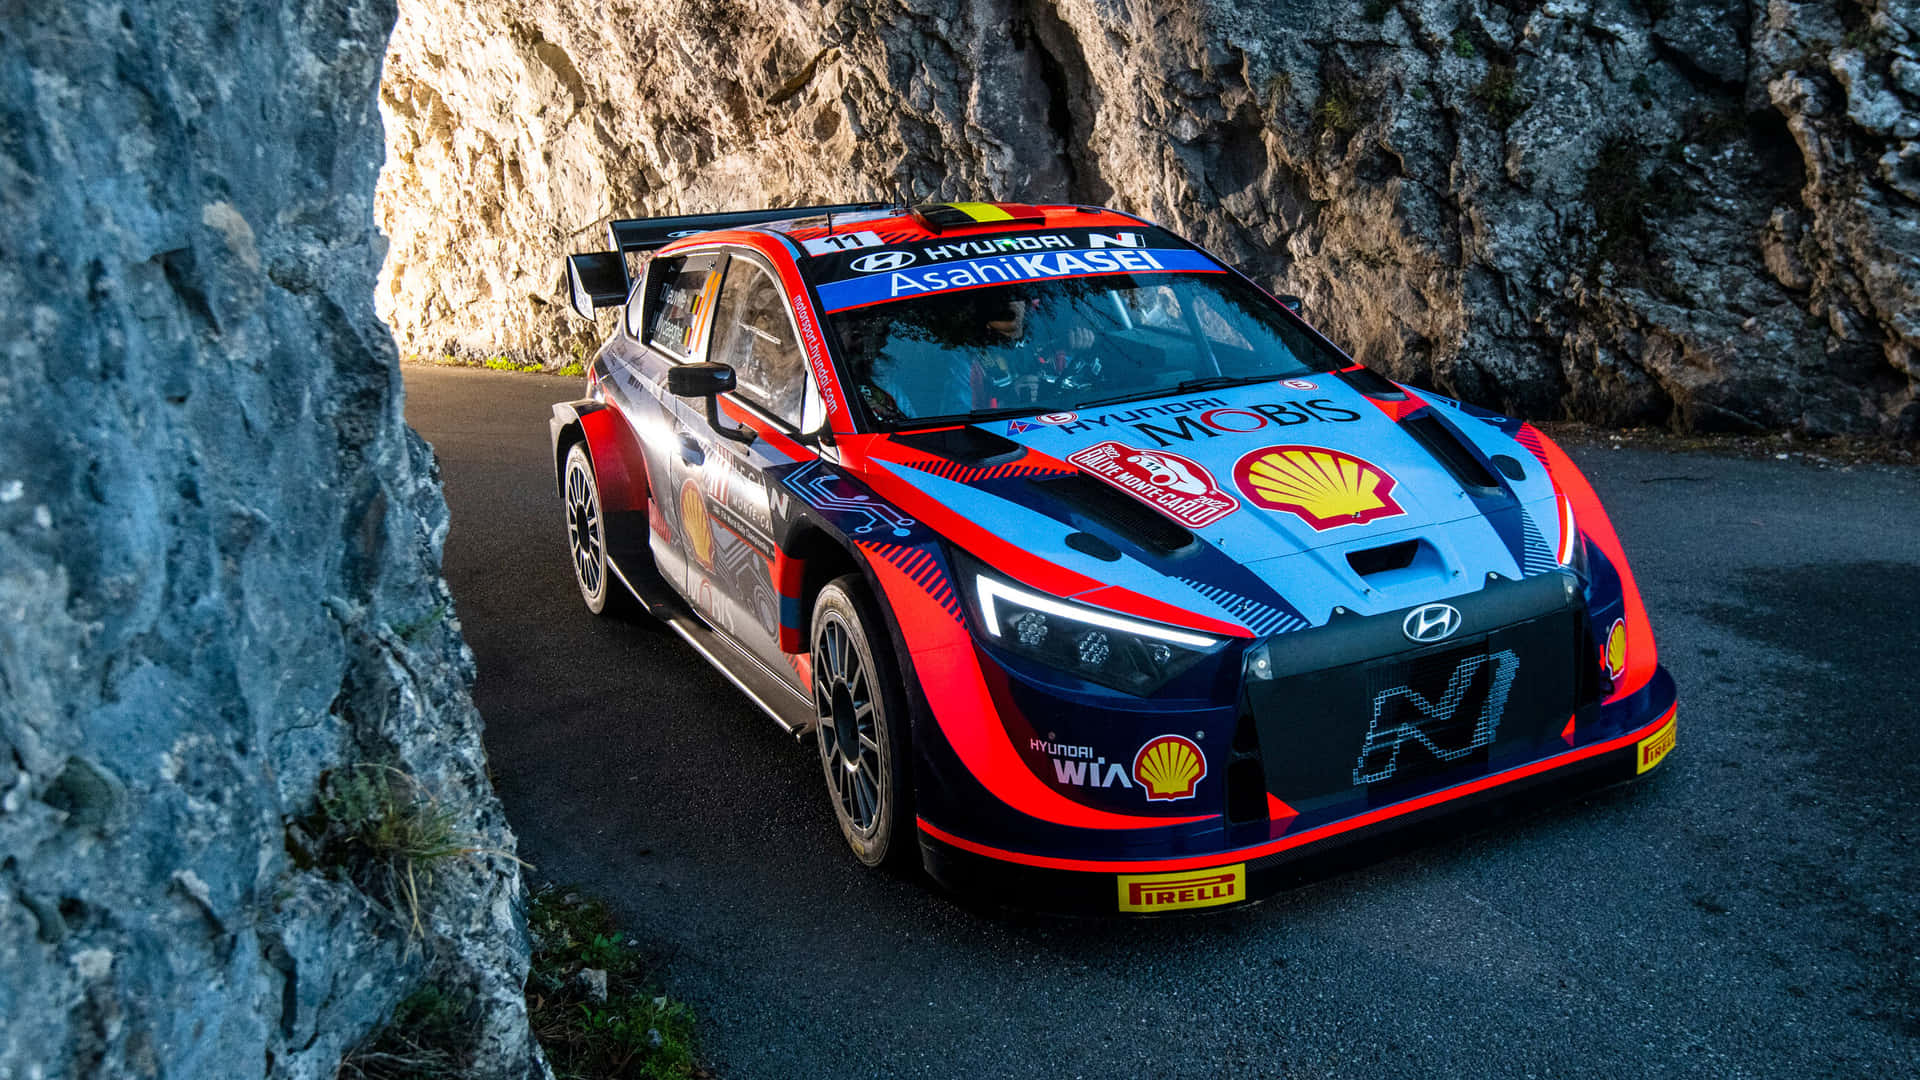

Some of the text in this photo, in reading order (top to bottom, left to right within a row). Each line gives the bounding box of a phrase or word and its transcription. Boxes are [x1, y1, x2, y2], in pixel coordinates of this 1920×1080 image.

[824, 234, 865, 249] 11
[924, 234, 1076, 261] HYUNDAI
[890, 249, 1165, 297] AsahiKASEI
[793, 294, 838, 415] motorsport.hyundai.com
[1057, 397, 1230, 435] HYUNDAI
[1132, 399, 1361, 447] MOBIS
[1102, 445, 1121, 459] 2022
[1145, 462, 1161, 471] 11
[1075, 448, 1219, 523] RALLYE MONTE-CARLO
[1193, 495, 1231, 509] 2022
[1030, 738, 1094, 759] HYUNDAI
[1128, 873, 1236, 906] PIRELLI
